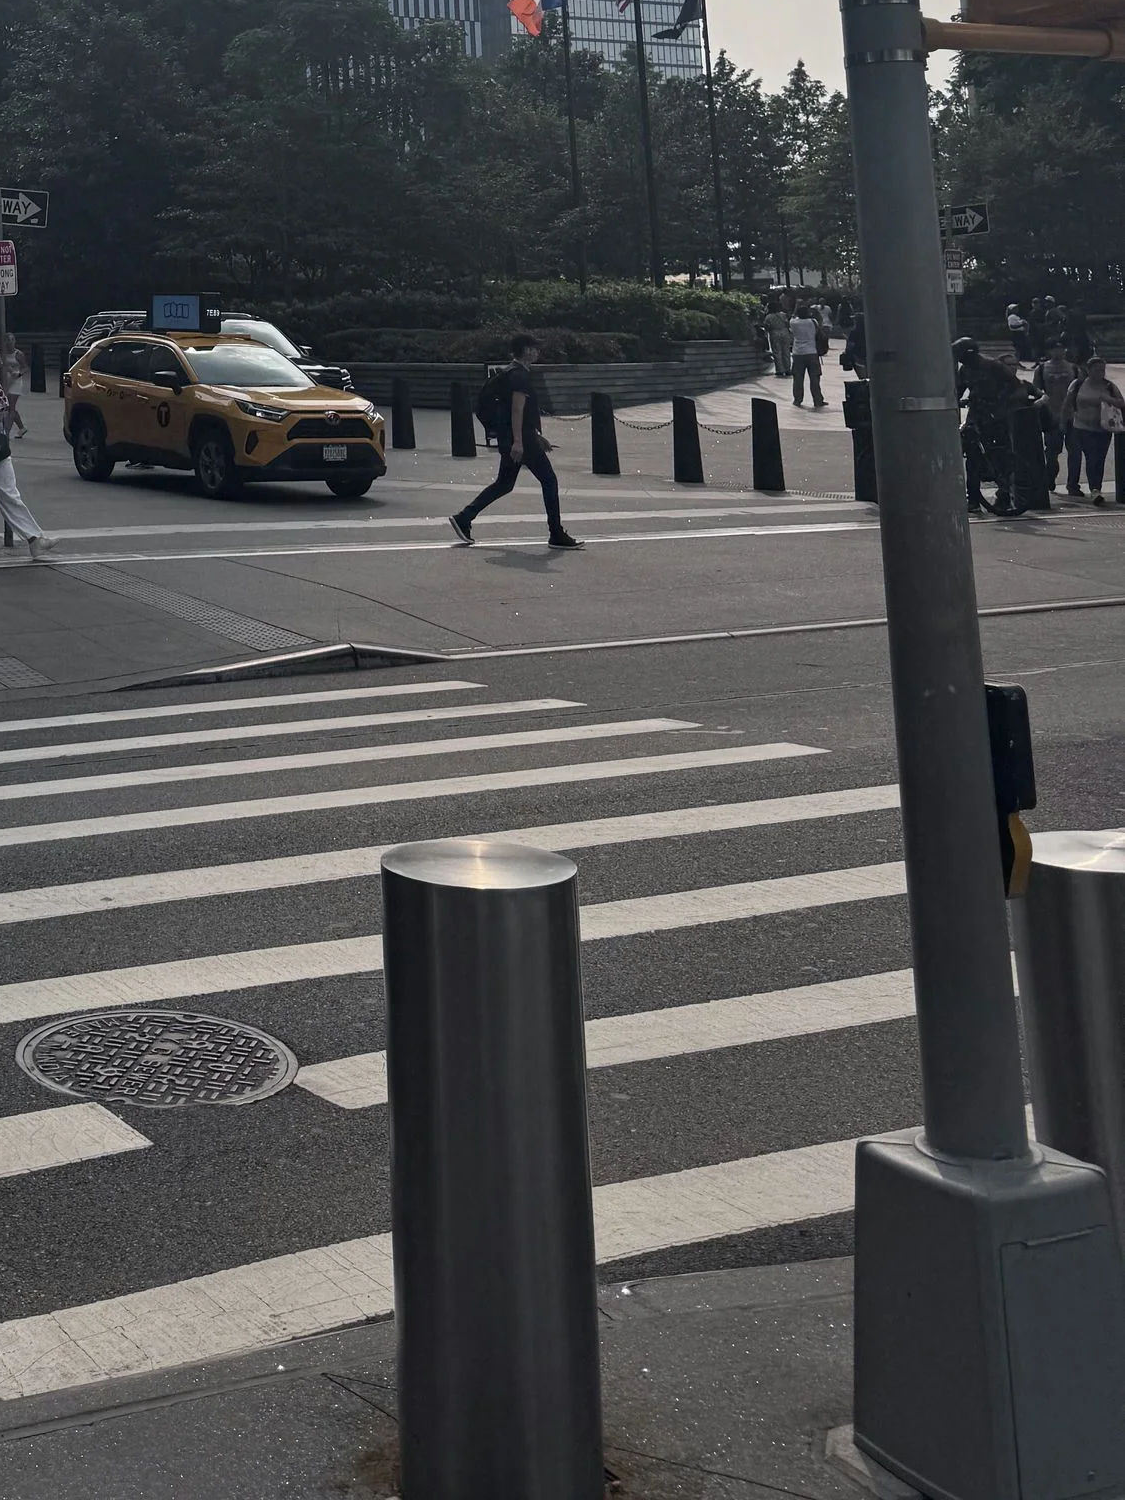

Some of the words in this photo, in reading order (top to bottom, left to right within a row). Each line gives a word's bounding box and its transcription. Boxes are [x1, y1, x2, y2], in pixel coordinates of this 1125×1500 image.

[2, 199, 32, 215] WAY
[955, 214, 976, 228] WAY
[0, 245, 13, 254] NOT
[114, 1060, 162, 1096] SEWER
